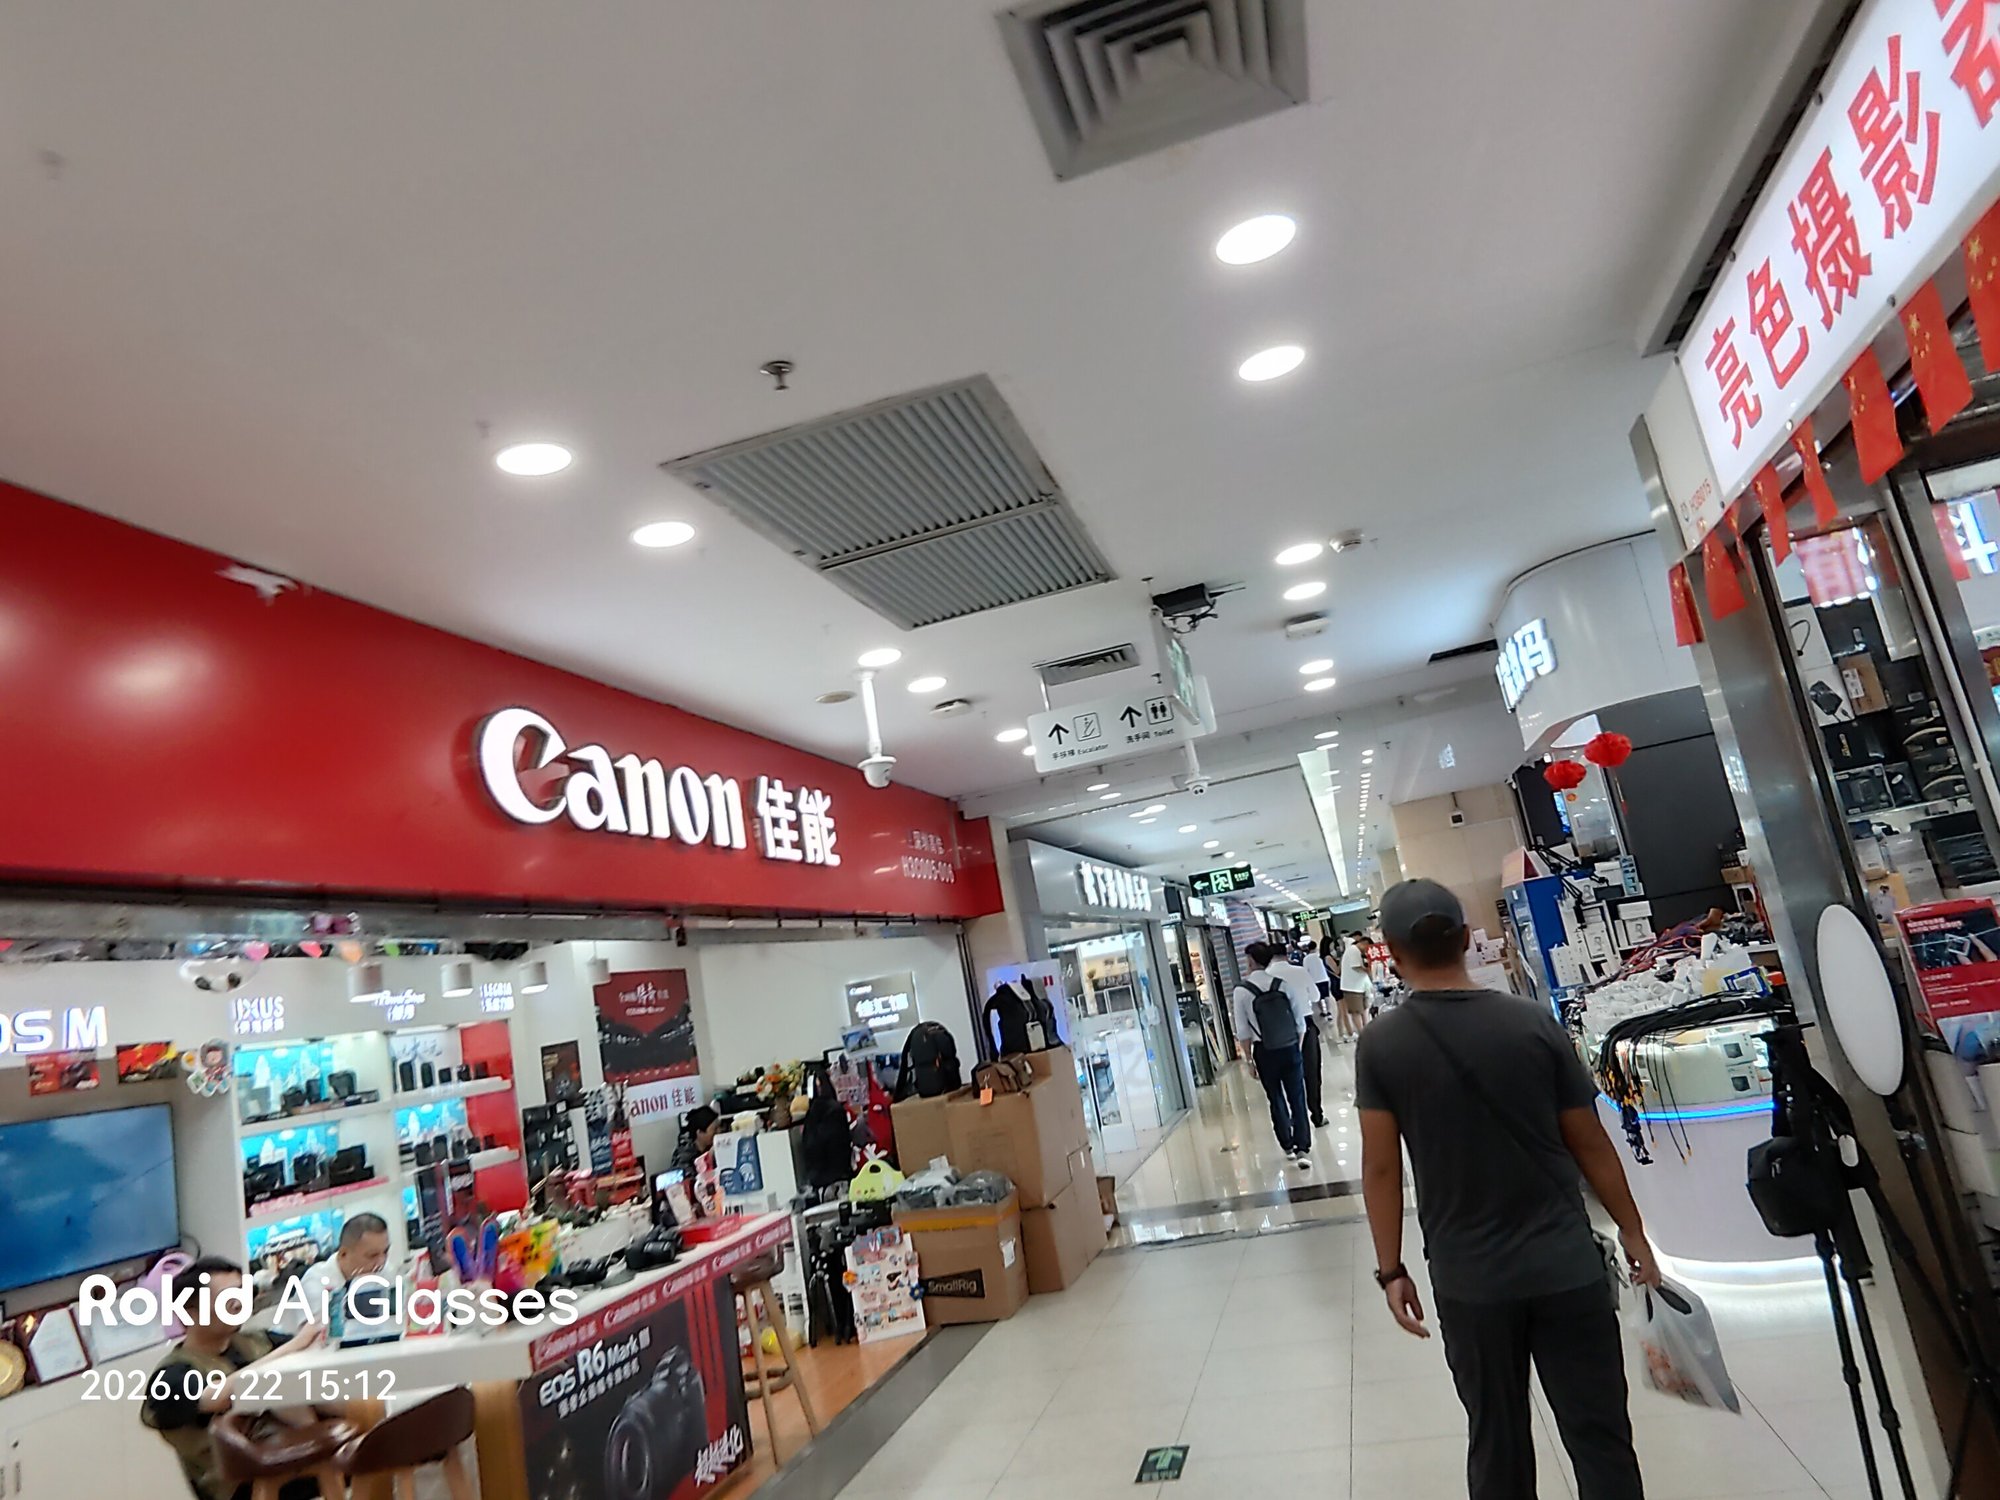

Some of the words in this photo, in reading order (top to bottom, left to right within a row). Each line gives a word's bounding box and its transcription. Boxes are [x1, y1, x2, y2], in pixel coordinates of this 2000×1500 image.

[1154, 728, 1175, 737] Toilet
[480, 707, 746, 848] Canon
[756, 775, 841, 866] 佳能
[234, 996, 284, 1019] IXUS
[64, 1005, 108, 1050] M
[630, 1092, 668, 1117] anon
[928, 1279, 977, 1294] SmallRig
[539, 1367, 576, 1408] EOS
[577, 1339, 606, 1386] R6
[606, 1333, 640, 1370] Mark
